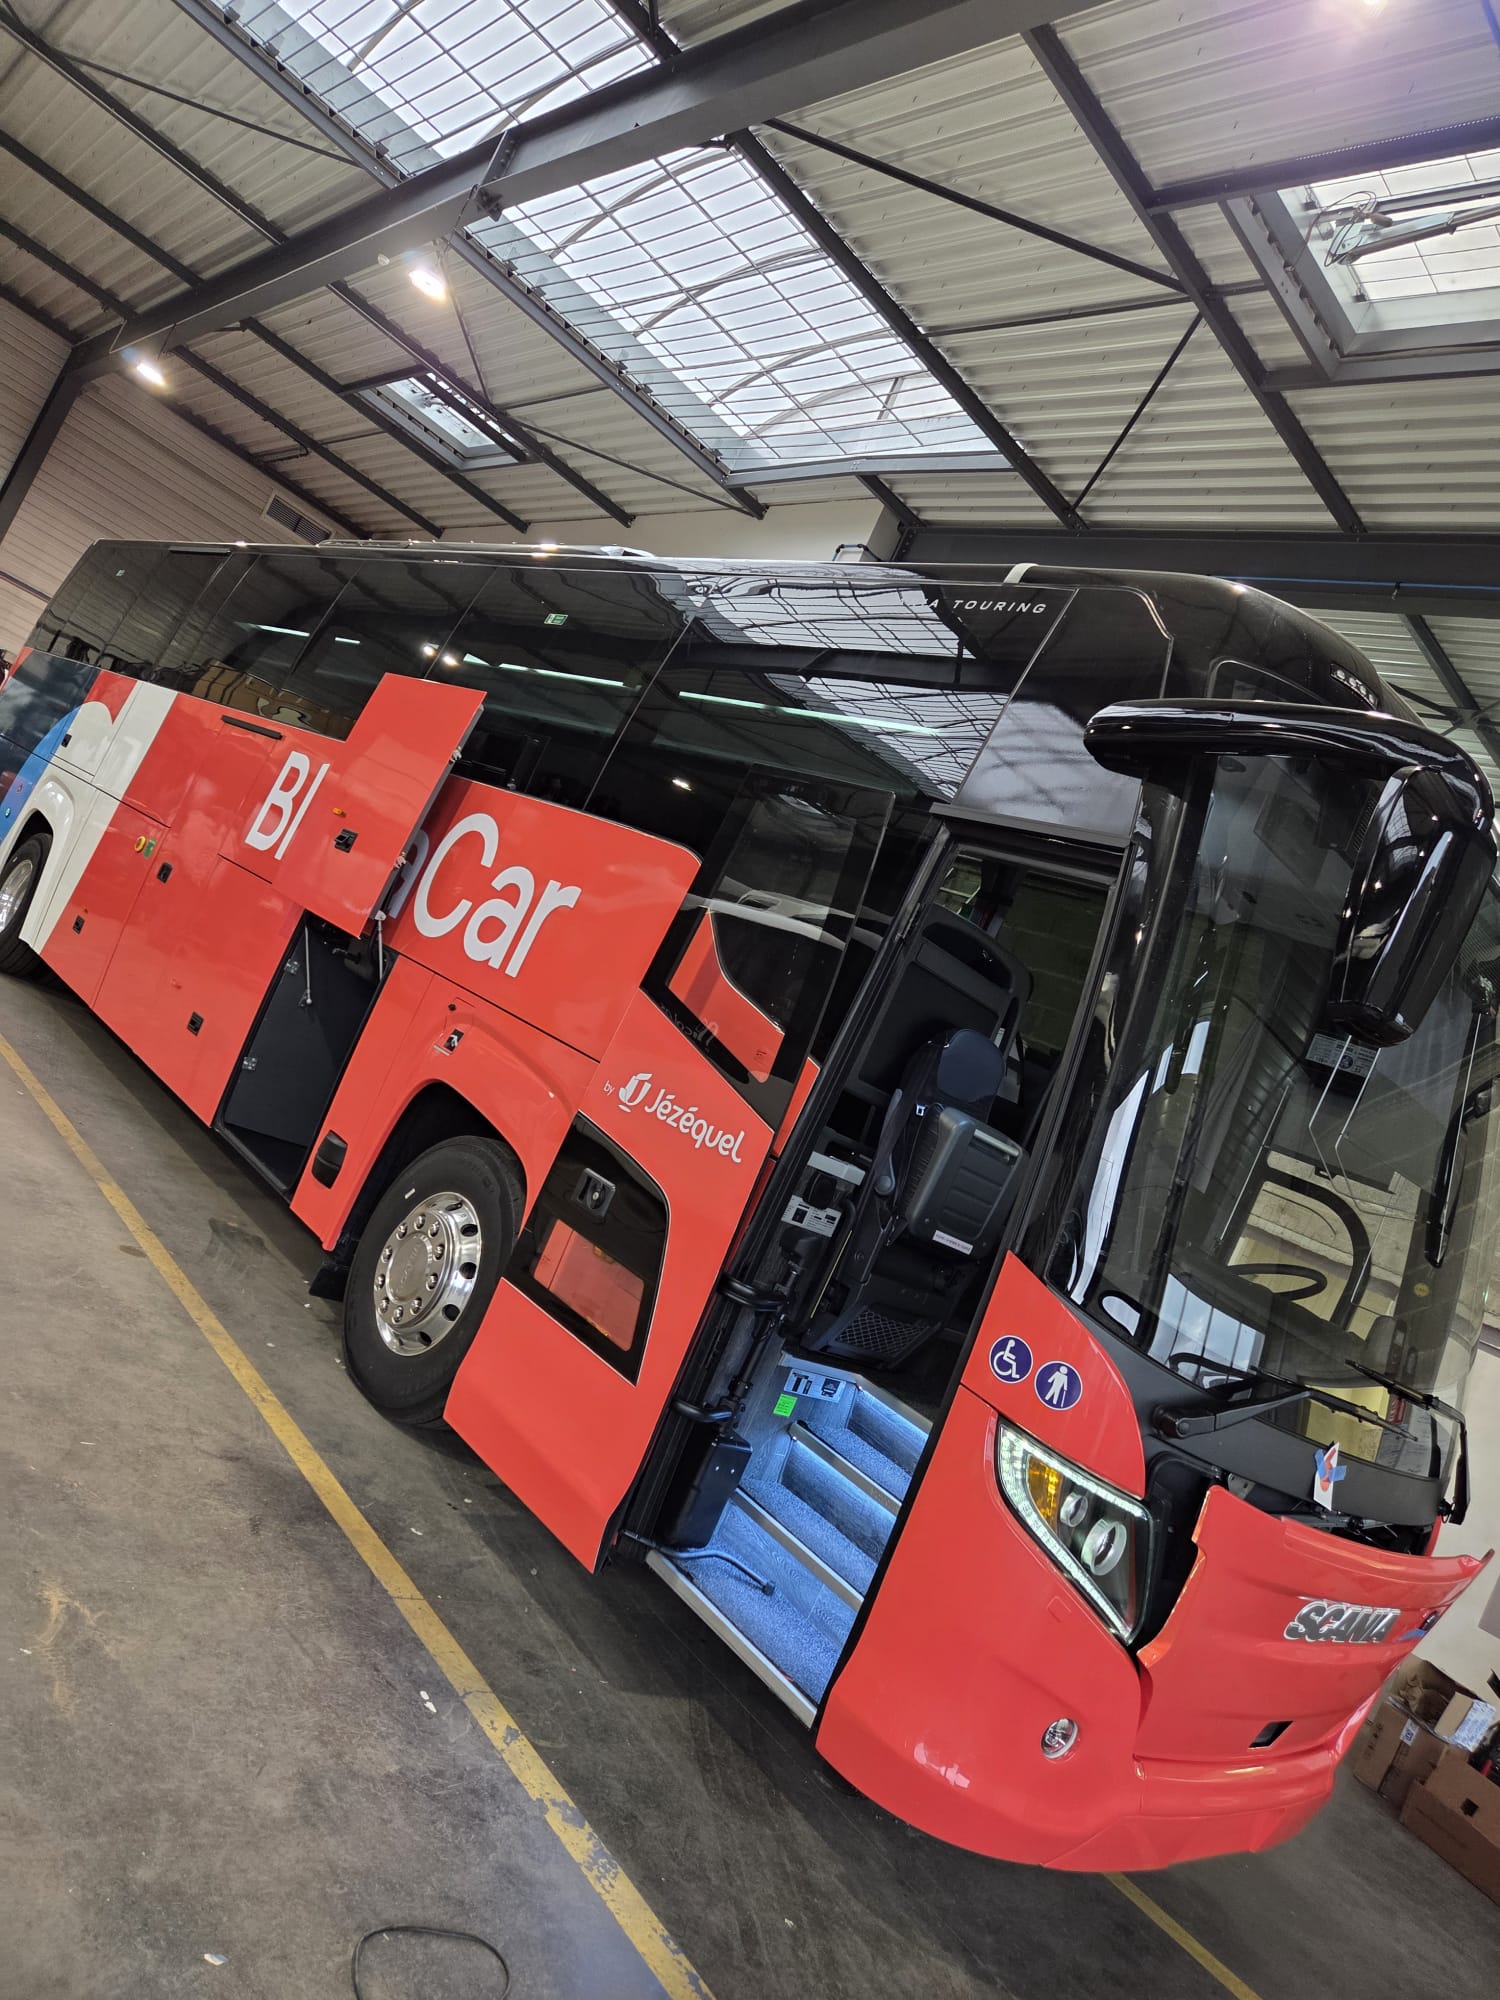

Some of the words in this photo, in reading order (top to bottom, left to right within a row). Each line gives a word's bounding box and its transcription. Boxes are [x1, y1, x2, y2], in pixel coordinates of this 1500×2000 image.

[953, 600, 1047, 614] TOURING
[603, 1080, 616, 1095] by
[644, 1088, 745, 1163] Jézéquel
